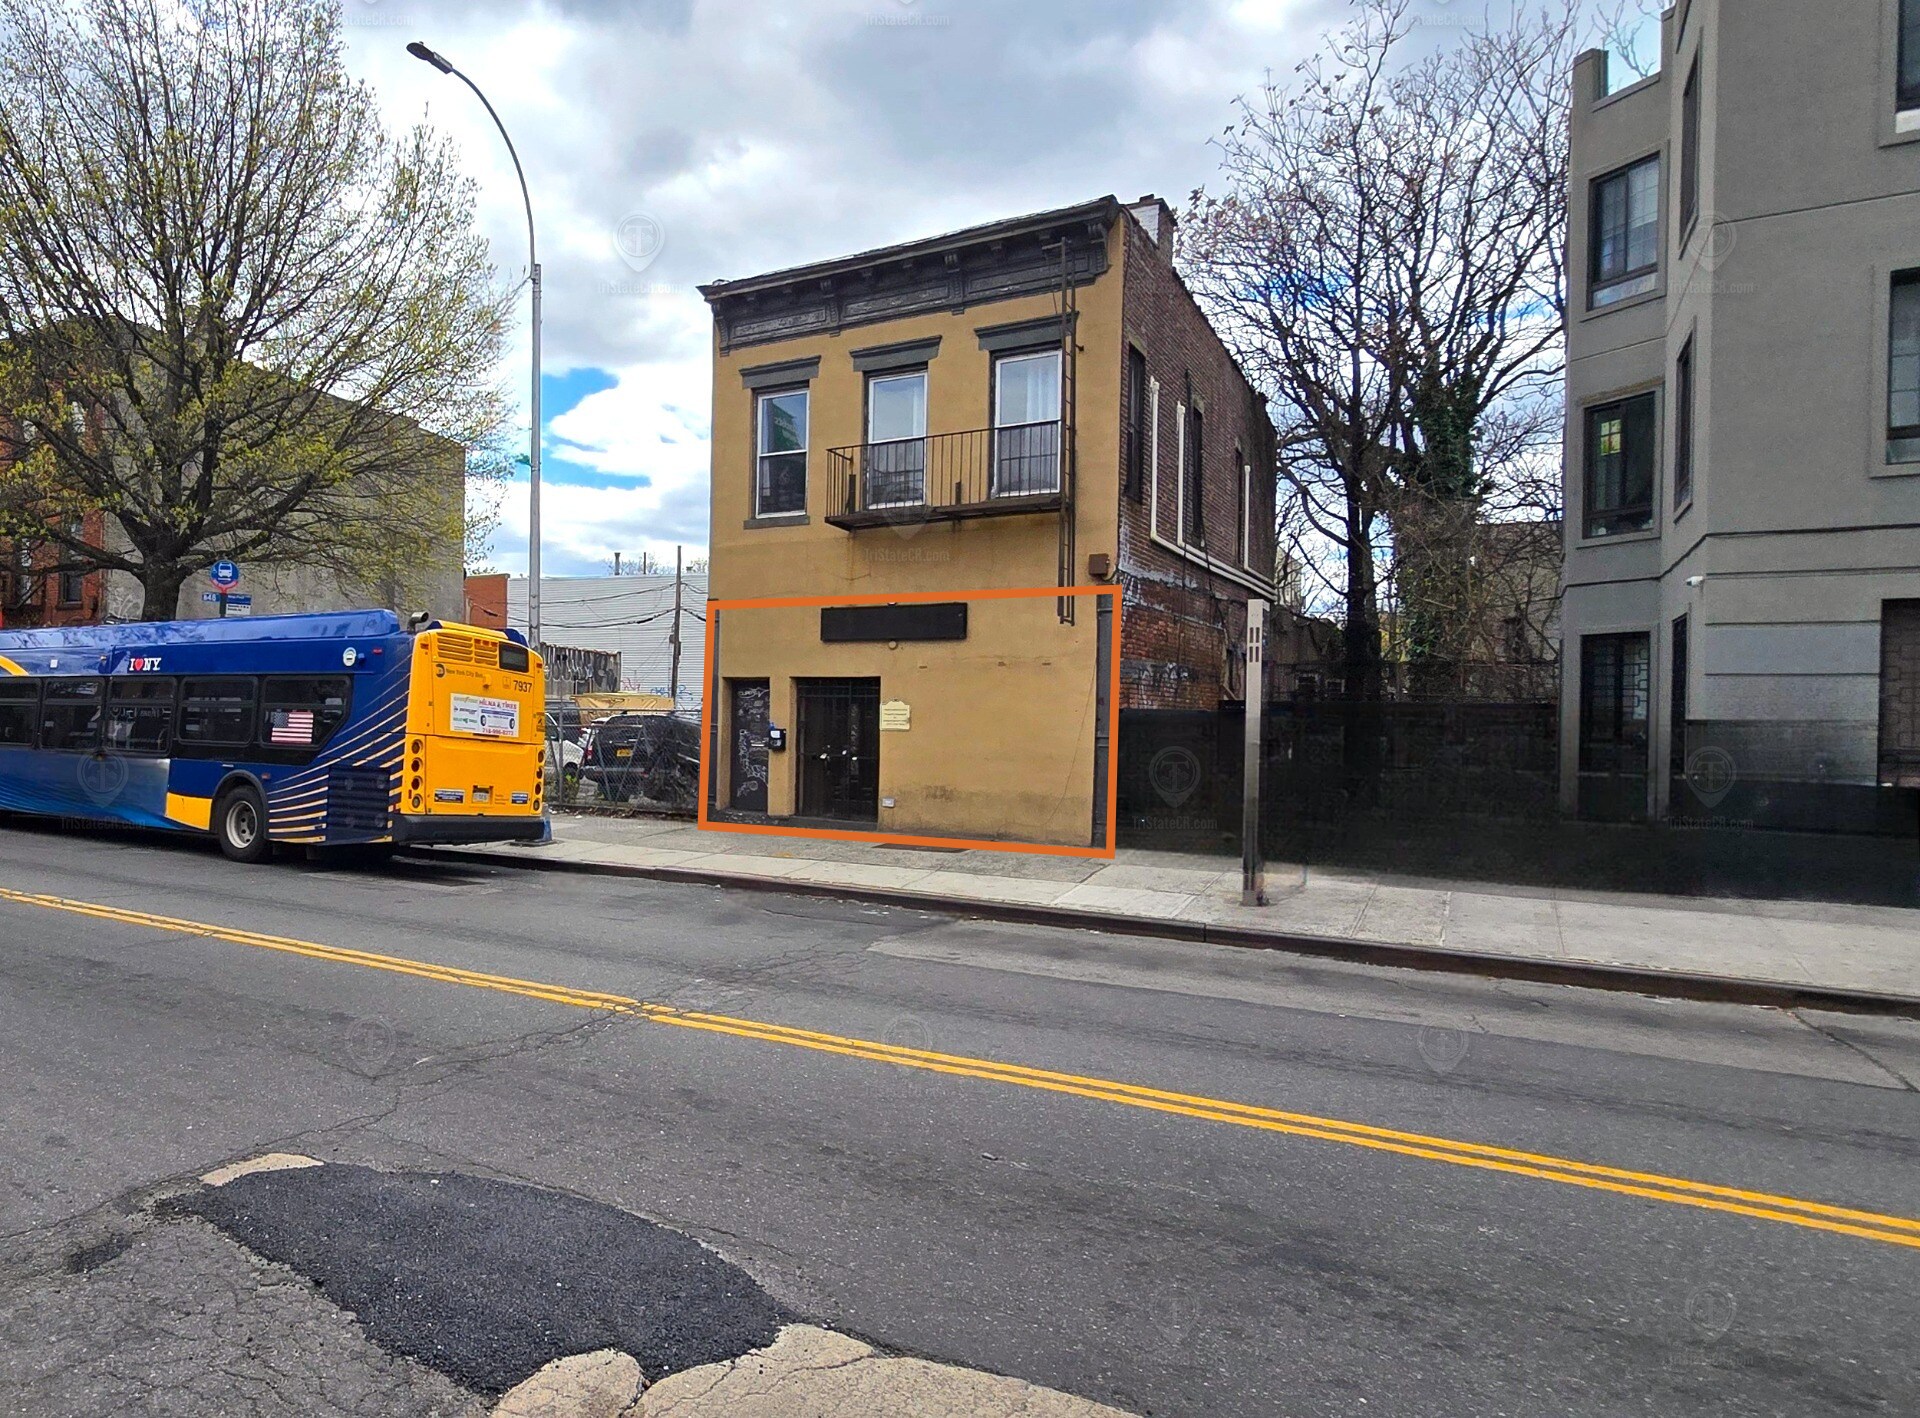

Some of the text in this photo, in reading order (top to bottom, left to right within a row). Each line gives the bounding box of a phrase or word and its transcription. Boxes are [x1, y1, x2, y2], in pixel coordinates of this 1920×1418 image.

[129, 657, 162, 671] I NY
[513, 680, 532, 693] 7937
